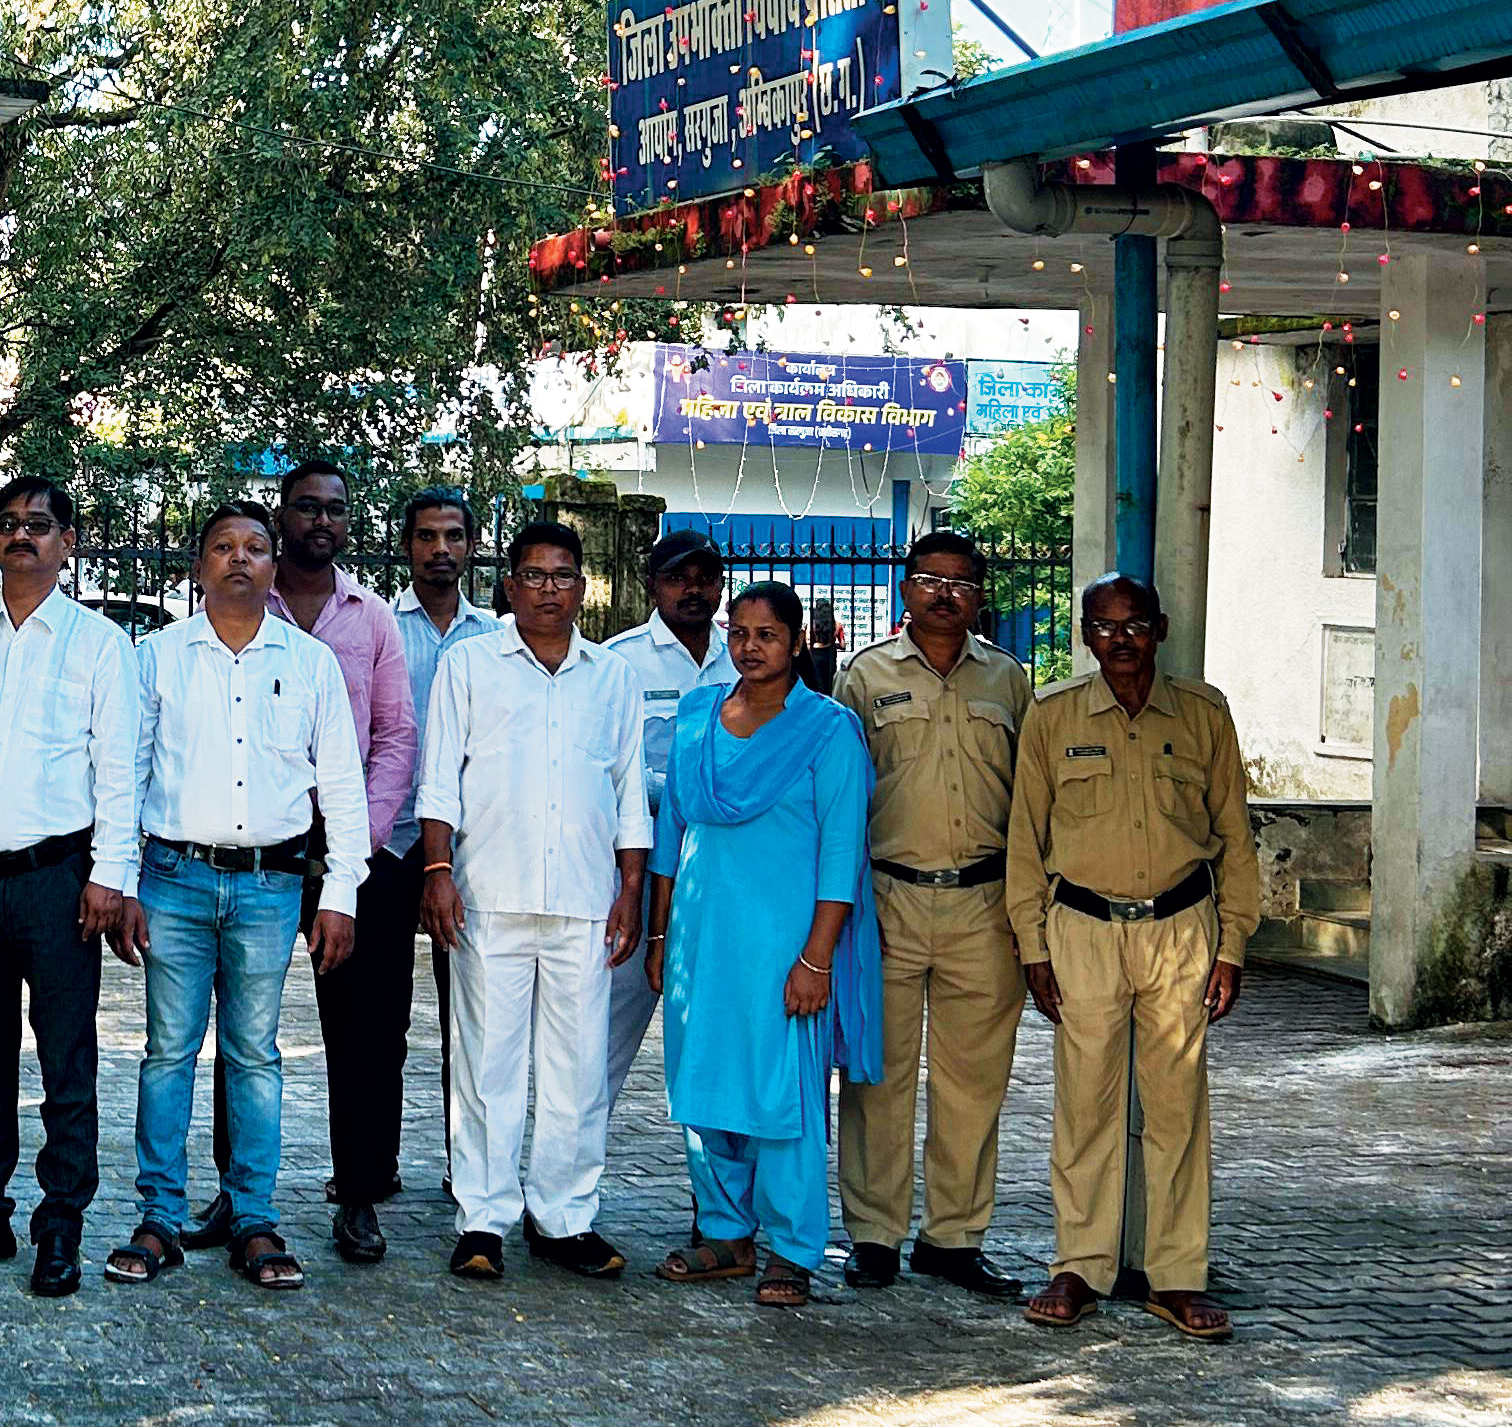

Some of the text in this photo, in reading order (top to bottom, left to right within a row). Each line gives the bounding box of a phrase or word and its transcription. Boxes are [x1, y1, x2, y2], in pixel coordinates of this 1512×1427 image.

[619, 8, 665, 86] जिला
[729, 375, 767, 394] जिला
[827, 379, 890, 400] अधिकारी
[977, 374, 1022, 398] जिला
[679, 394, 741, 421] महिला
[815, 399, 879, 425] विकास
[880, 402, 938, 427] विभाग
[975, 398, 1046, 423] महिला एवं
